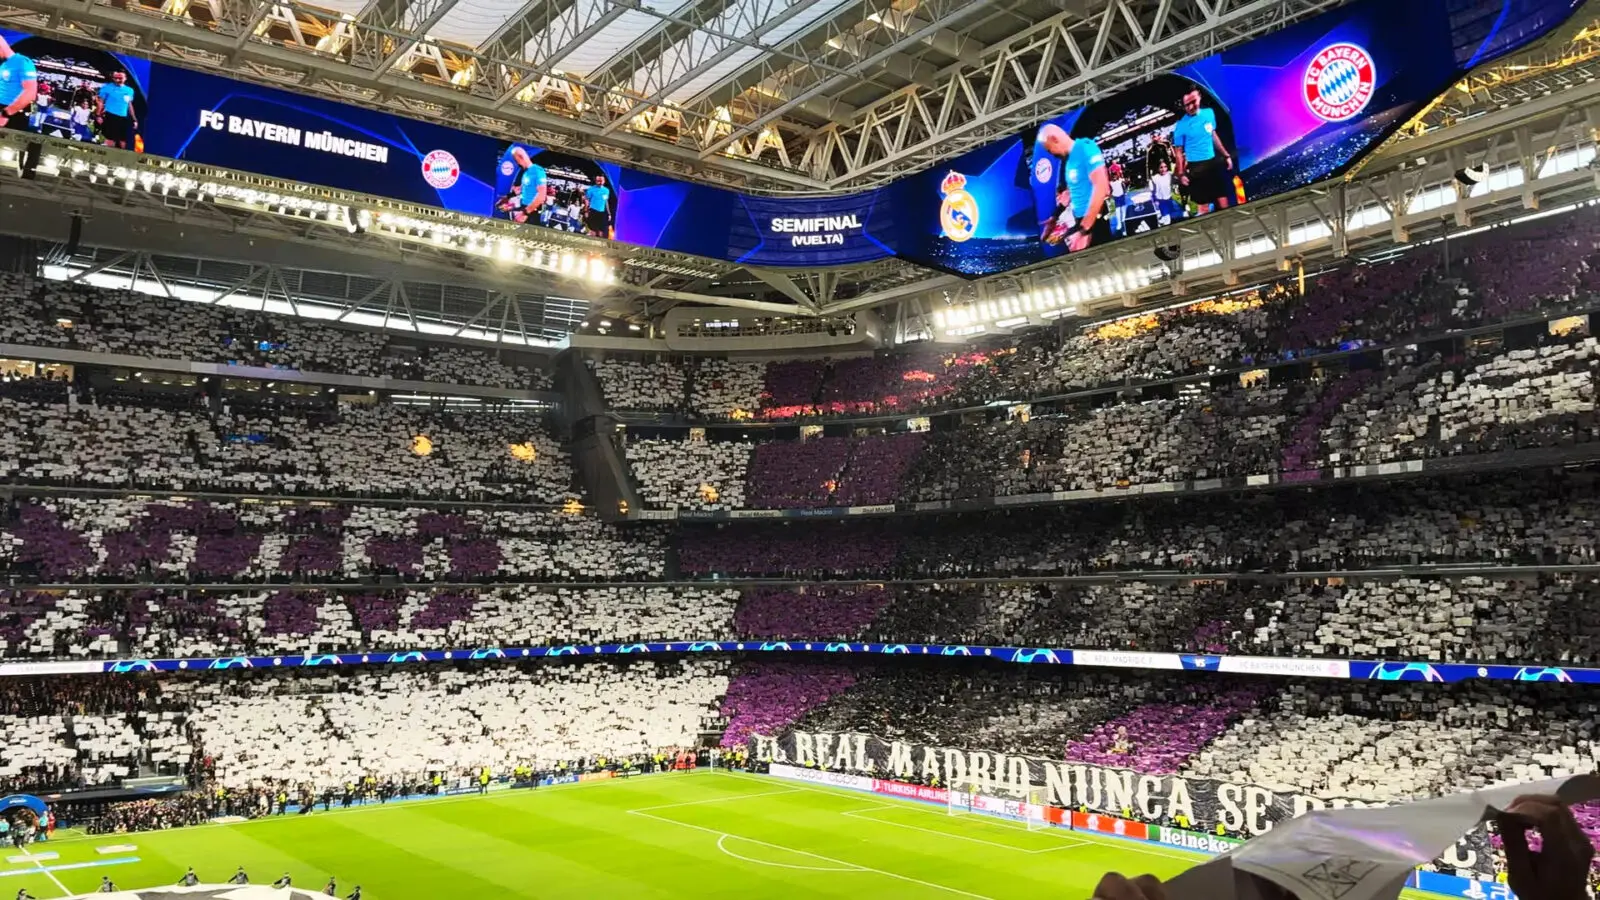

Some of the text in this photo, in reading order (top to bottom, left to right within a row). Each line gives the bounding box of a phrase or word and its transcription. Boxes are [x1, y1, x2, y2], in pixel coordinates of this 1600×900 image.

[1308, 47, 1368, 85] FC BAYERN
[200, 109, 389, 163] FC BAYERN MÜNCHEN
[771, 214, 863, 233] SEMIFINAL
[791, 233, 844, 247] (VUELTA)
[756, 734, 787, 763] EL
[794, 732, 874, 772] REAL
[887, 740, 1030, 798] MADRID
[1043, 761, 1199, 826] NUNCA
[1216, 782, 1274, 837] SE
[883, 782, 950, 802] TURKISH AIRLINE
